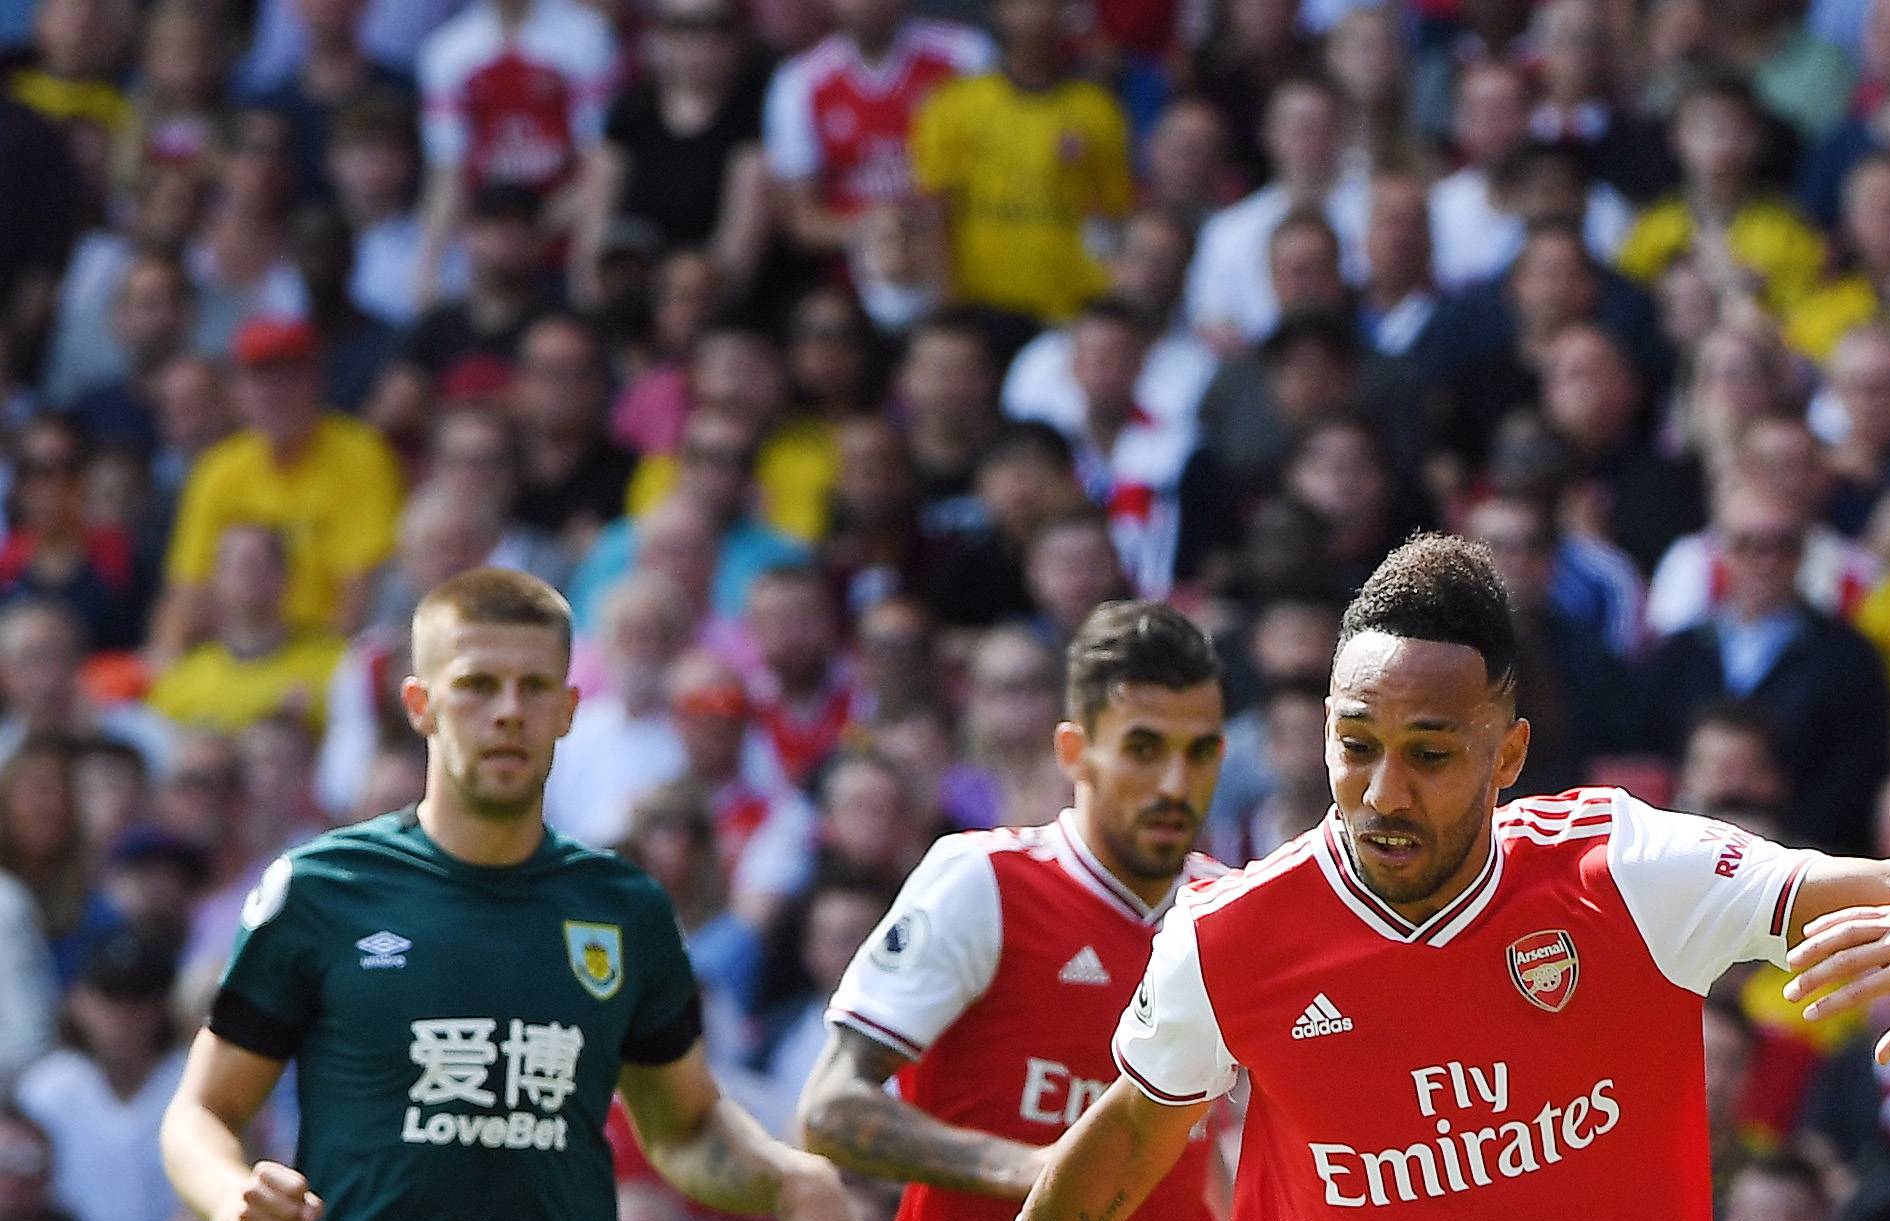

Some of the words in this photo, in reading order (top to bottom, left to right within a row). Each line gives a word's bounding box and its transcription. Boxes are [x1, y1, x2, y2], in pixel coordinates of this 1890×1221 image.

[1516, 940, 1565, 965] Arsenal
[1291, 1017, 1354, 1040] adidas
[407, 1017, 585, 1113] 爱博
[1410, 1061, 1509, 1117] Fly
[400, 1105, 569, 1151] LoveBet
[1307, 1078, 1620, 1208] Emirates
